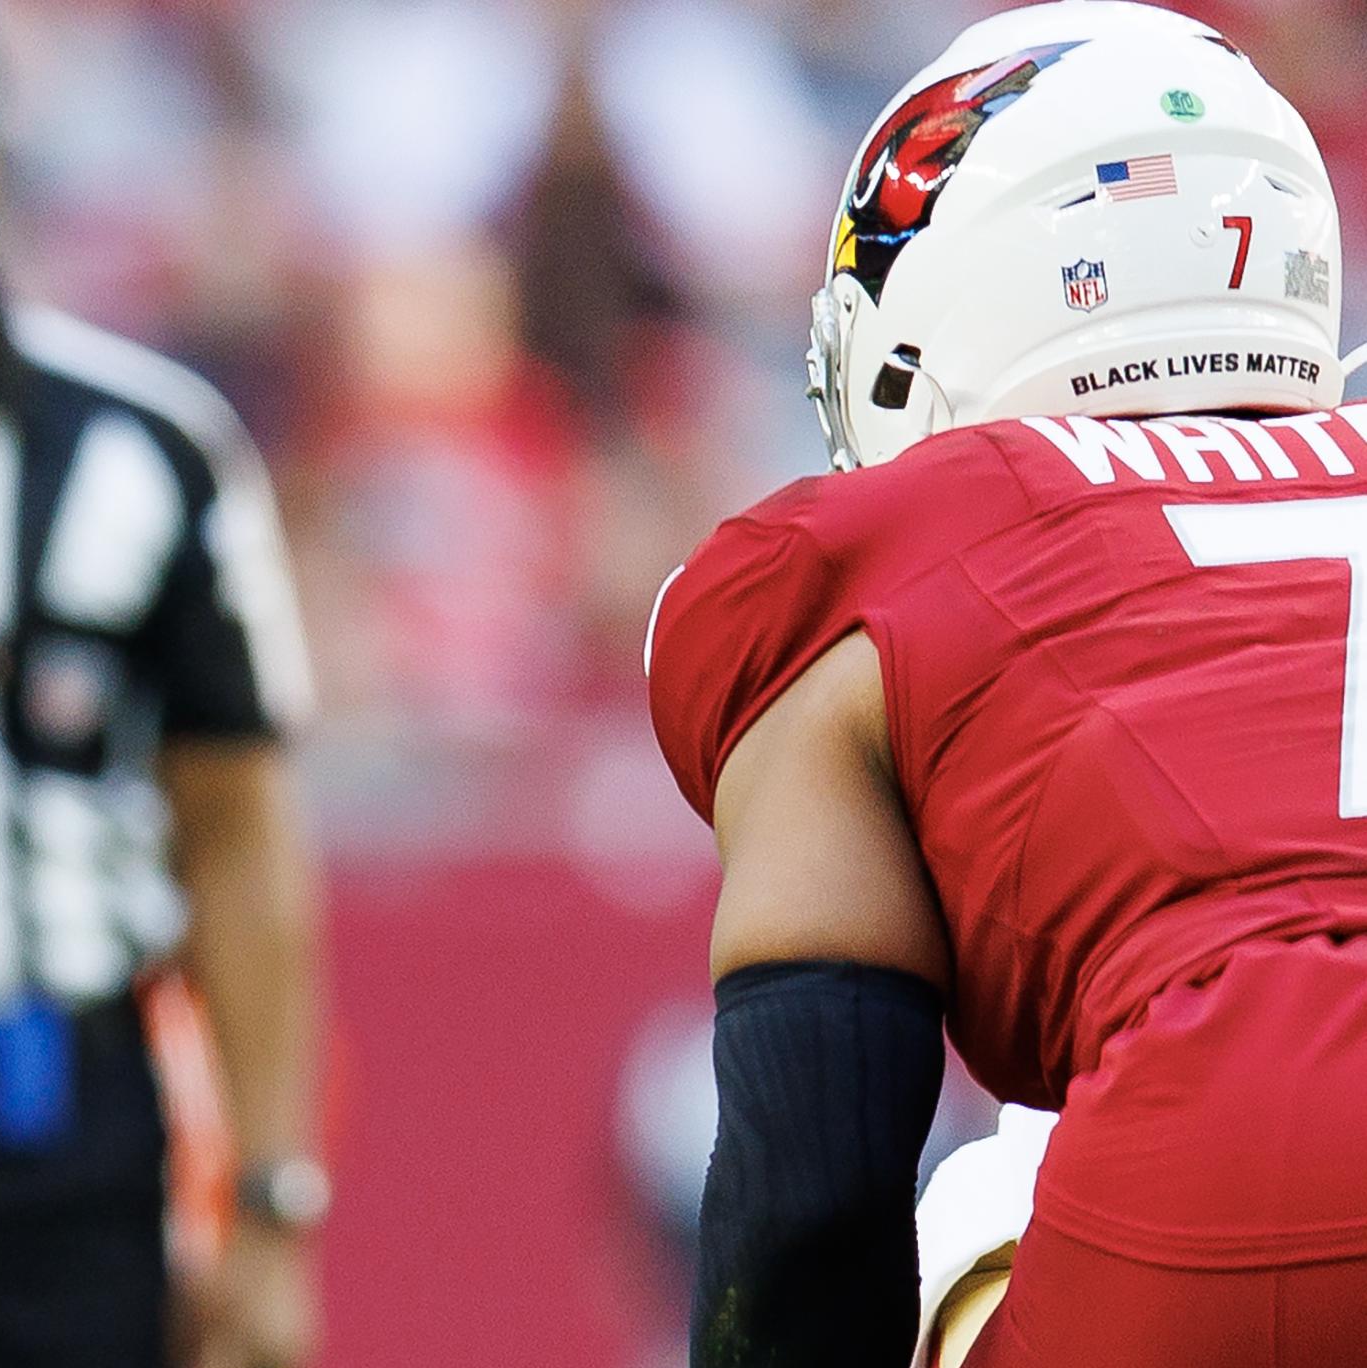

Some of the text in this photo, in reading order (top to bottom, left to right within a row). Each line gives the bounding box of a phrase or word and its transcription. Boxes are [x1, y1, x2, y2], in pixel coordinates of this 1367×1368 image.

[1223, 216, 1253, 290] 7
[1069, 281, 1104, 306] NFL
[1071, 353, 1321, 396] BLACK LIVES MATTER
